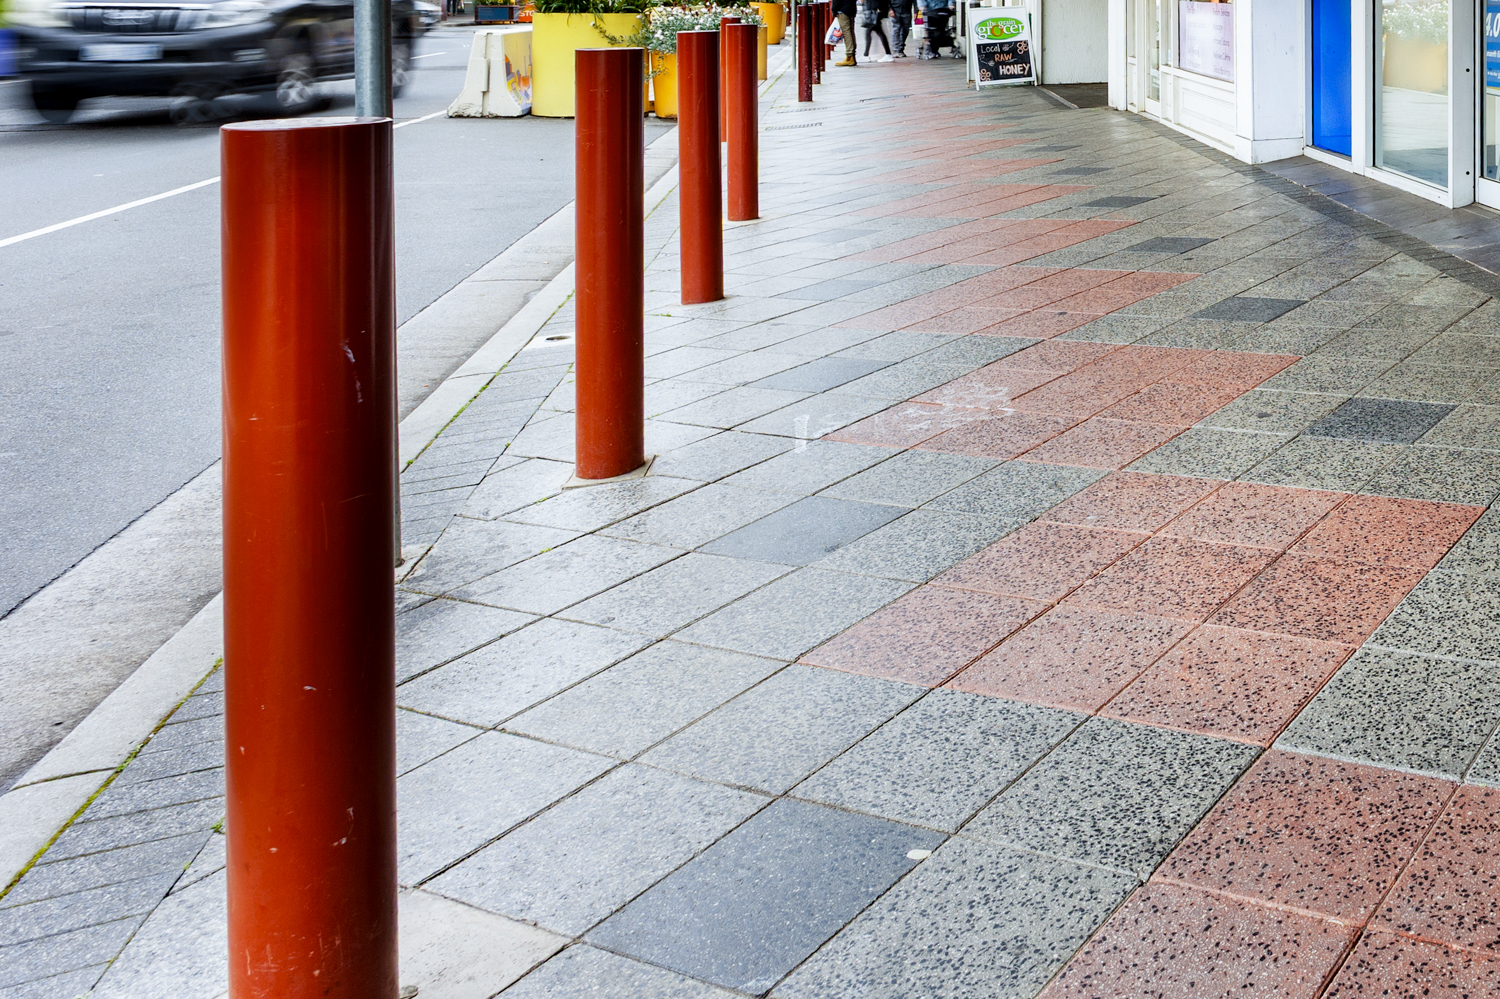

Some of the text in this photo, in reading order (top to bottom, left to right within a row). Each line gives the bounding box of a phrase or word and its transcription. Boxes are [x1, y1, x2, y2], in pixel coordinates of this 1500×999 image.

[998, 19, 1015, 28] grain
[978, 23, 1024, 40] grocer
[981, 44, 1000, 53] Local
[995, 53, 1012, 62] RAW
[999, 64, 1030, 75] HONEY
